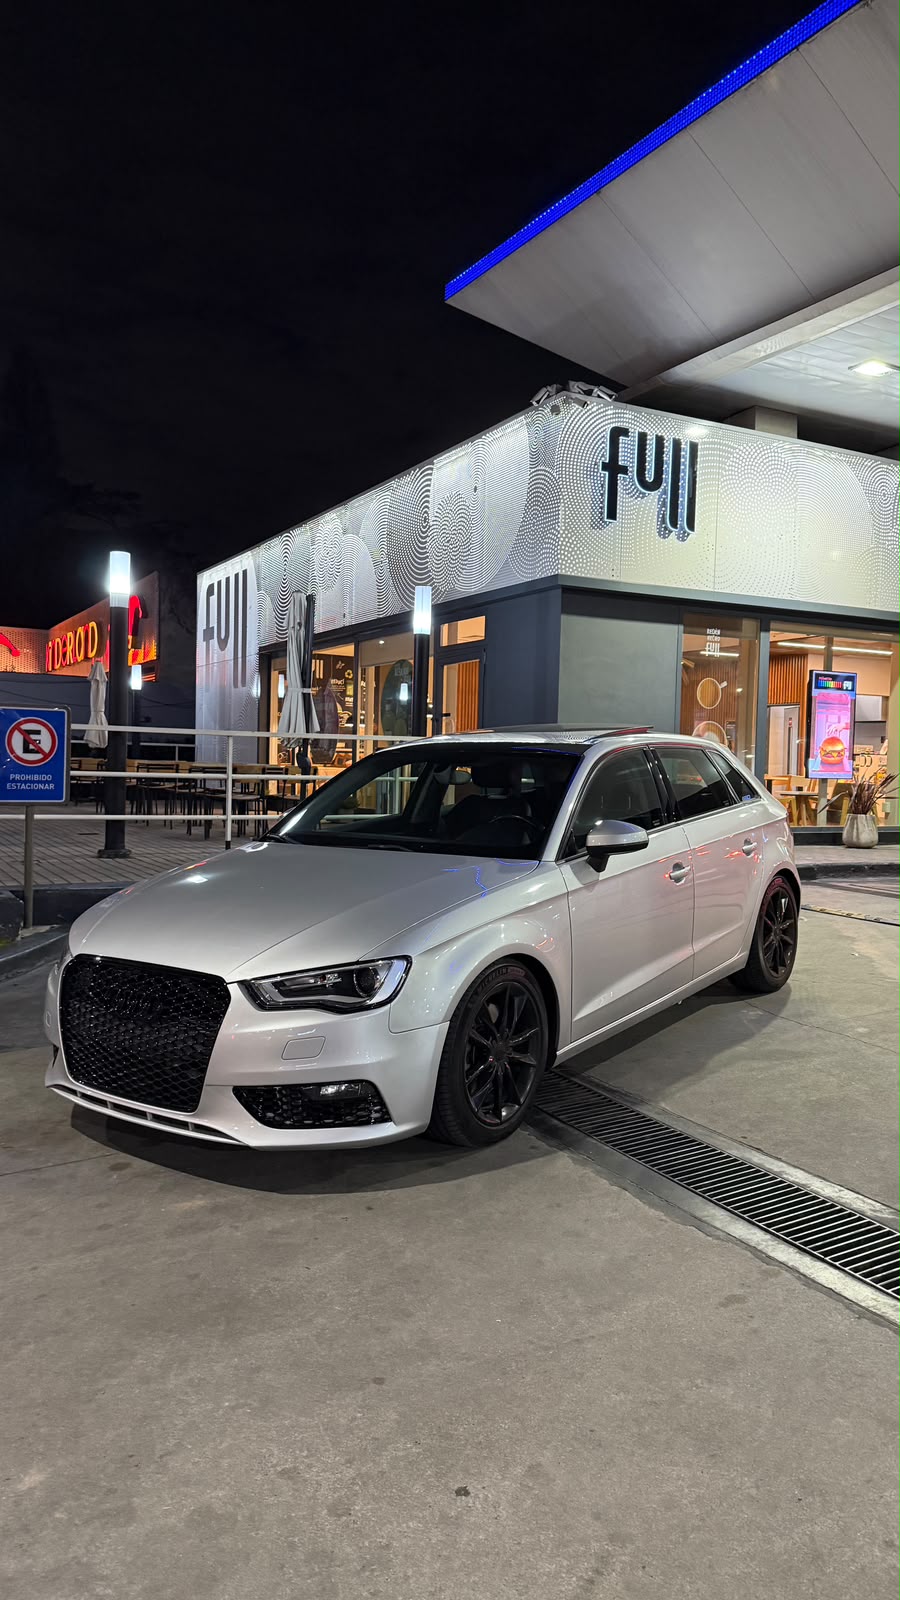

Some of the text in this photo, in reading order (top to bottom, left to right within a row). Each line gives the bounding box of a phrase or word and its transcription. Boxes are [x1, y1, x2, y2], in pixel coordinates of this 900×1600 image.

[600, 426, 699, 534] full
[203, 569, 247, 691] full
[6, 782, 55, 790] ESTACIONAR
